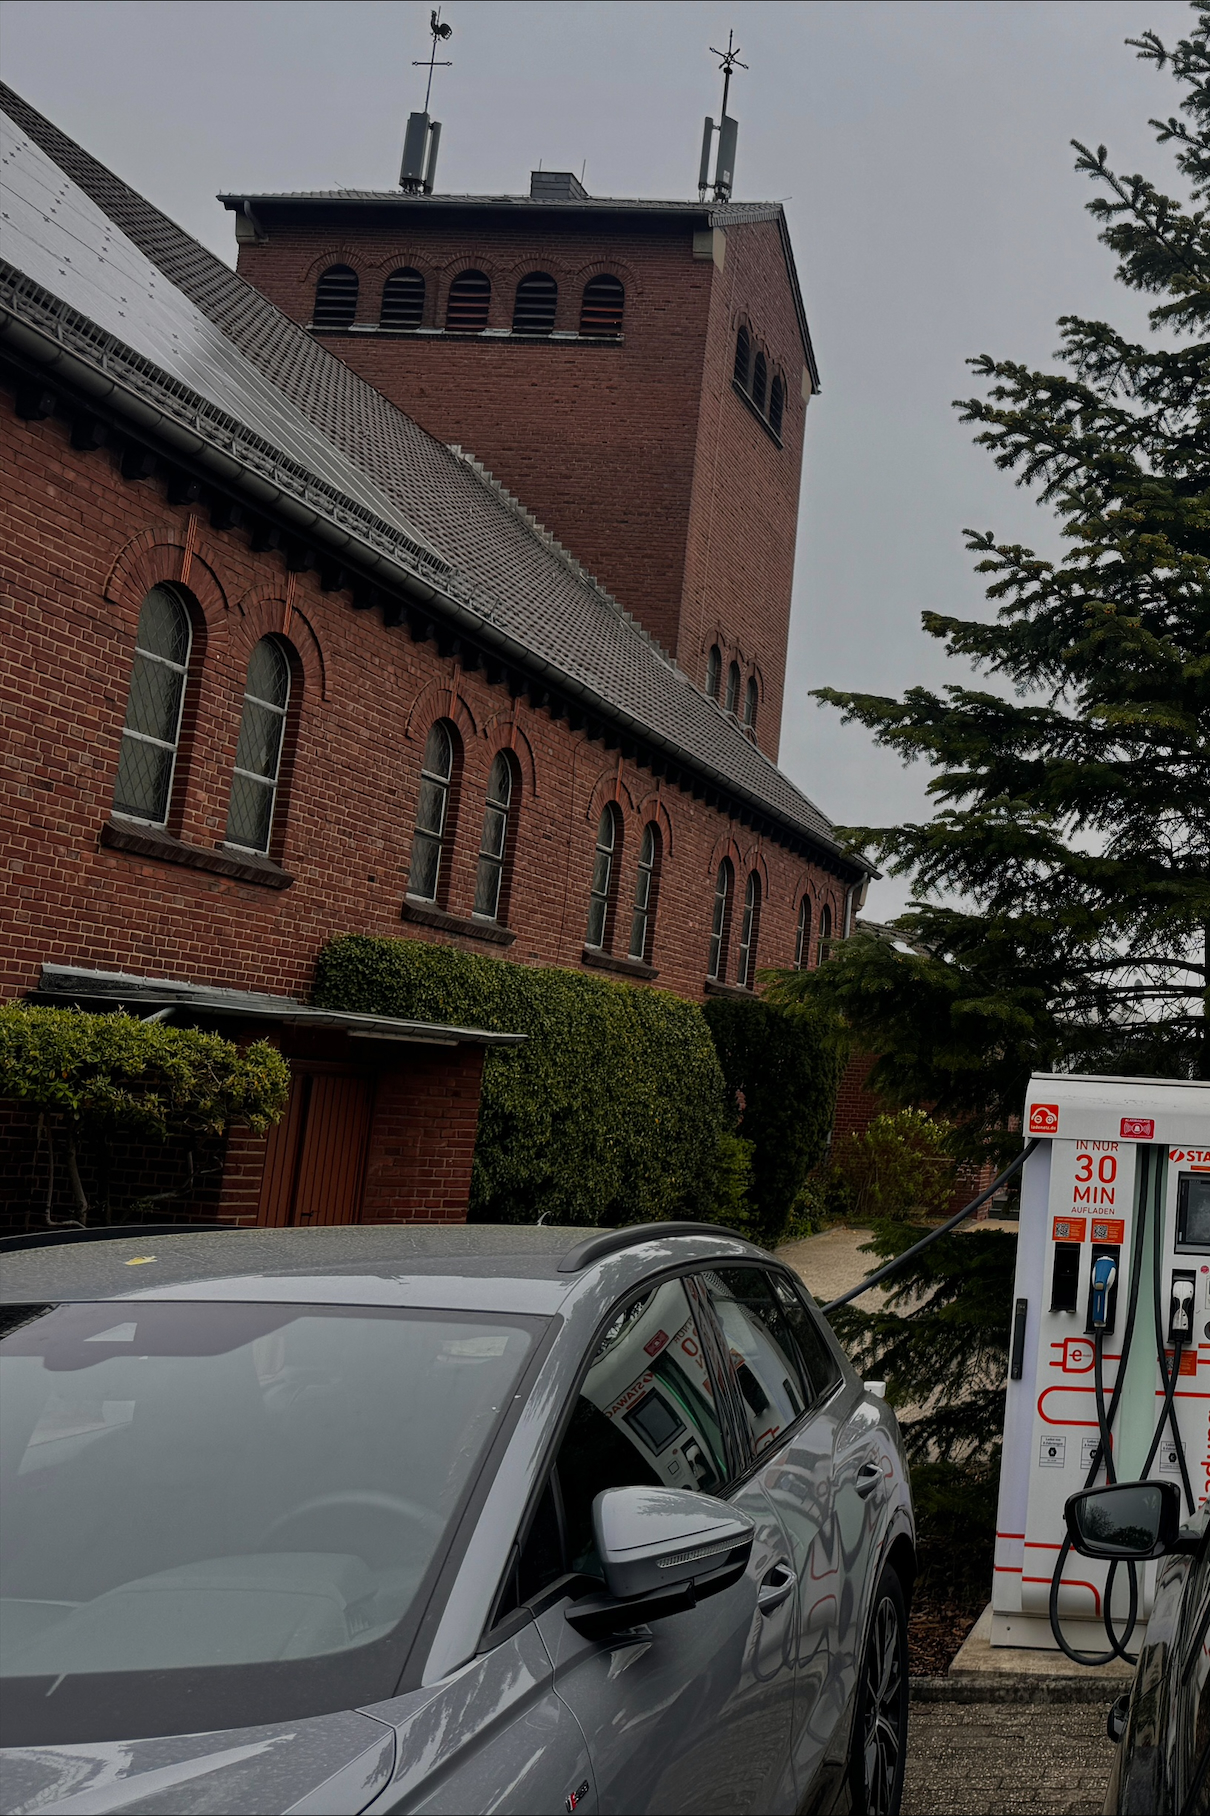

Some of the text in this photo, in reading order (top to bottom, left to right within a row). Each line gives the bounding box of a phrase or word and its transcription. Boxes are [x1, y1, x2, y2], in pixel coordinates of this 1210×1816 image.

[1076, 1140, 1119, 1151] IN NUR
[1075, 1154, 1117, 1184] 30
[1073, 1185, 1115, 1205] MIN
[1071, 1206, 1115, 1215] AUFLADEN
